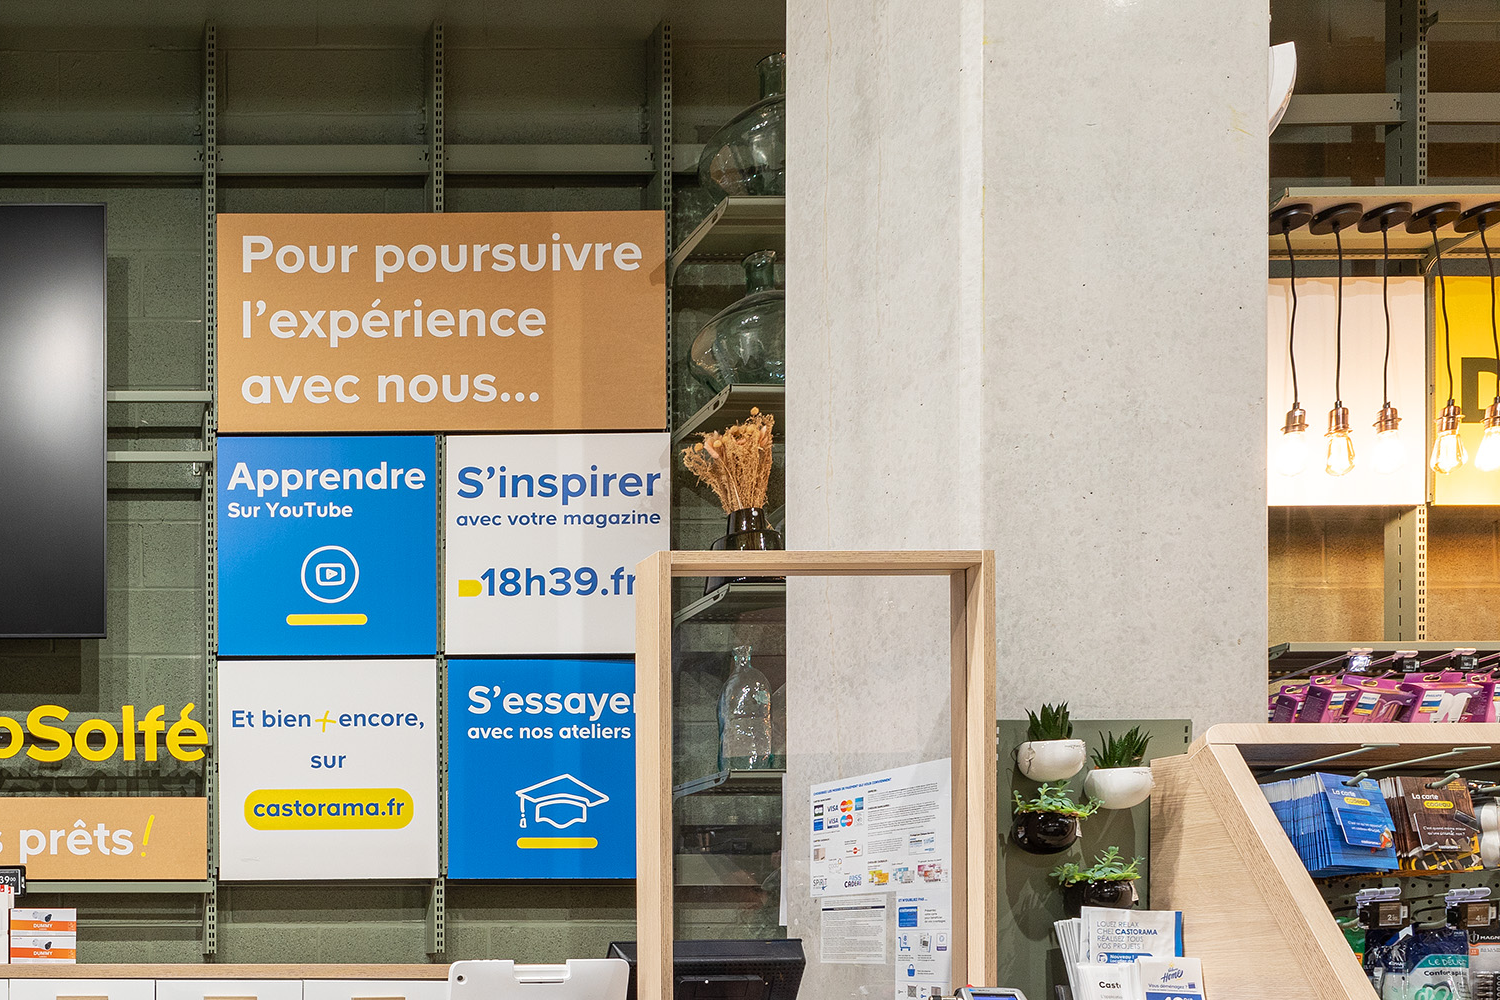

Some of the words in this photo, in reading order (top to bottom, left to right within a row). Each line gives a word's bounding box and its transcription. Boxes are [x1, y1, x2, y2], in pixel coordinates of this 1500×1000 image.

[242, 236, 357, 273] Pour
[376, 233, 642, 282] poursuivre
[242, 299, 546, 347] l'expérience
[242, 375, 360, 404] avec
[378, 373, 539, 403] nous...
[228, 462, 426, 497] Apprendre
[457, 465, 661, 505] S'inspirer
[228, 503, 260, 519] Sur
[266, 502, 352, 518] YouTube
[456, 512, 502, 527] avec
[507, 512, 556, 527] votre
[563, 510, 660, 529] magazine
[231, 711, 254, 728] Et
[262, 709, 311, 728] bien
[338, 710, 424, 730] encore,
[467, 725, 513, 739] avec
[519, 726, 553, 738] nos
[559, 724, 631, 739] ateliers
[310, 752, 346, 769] sur
[253, 798, 404, 818] castorama.fr
[19, 819, 133, 863] prêts
